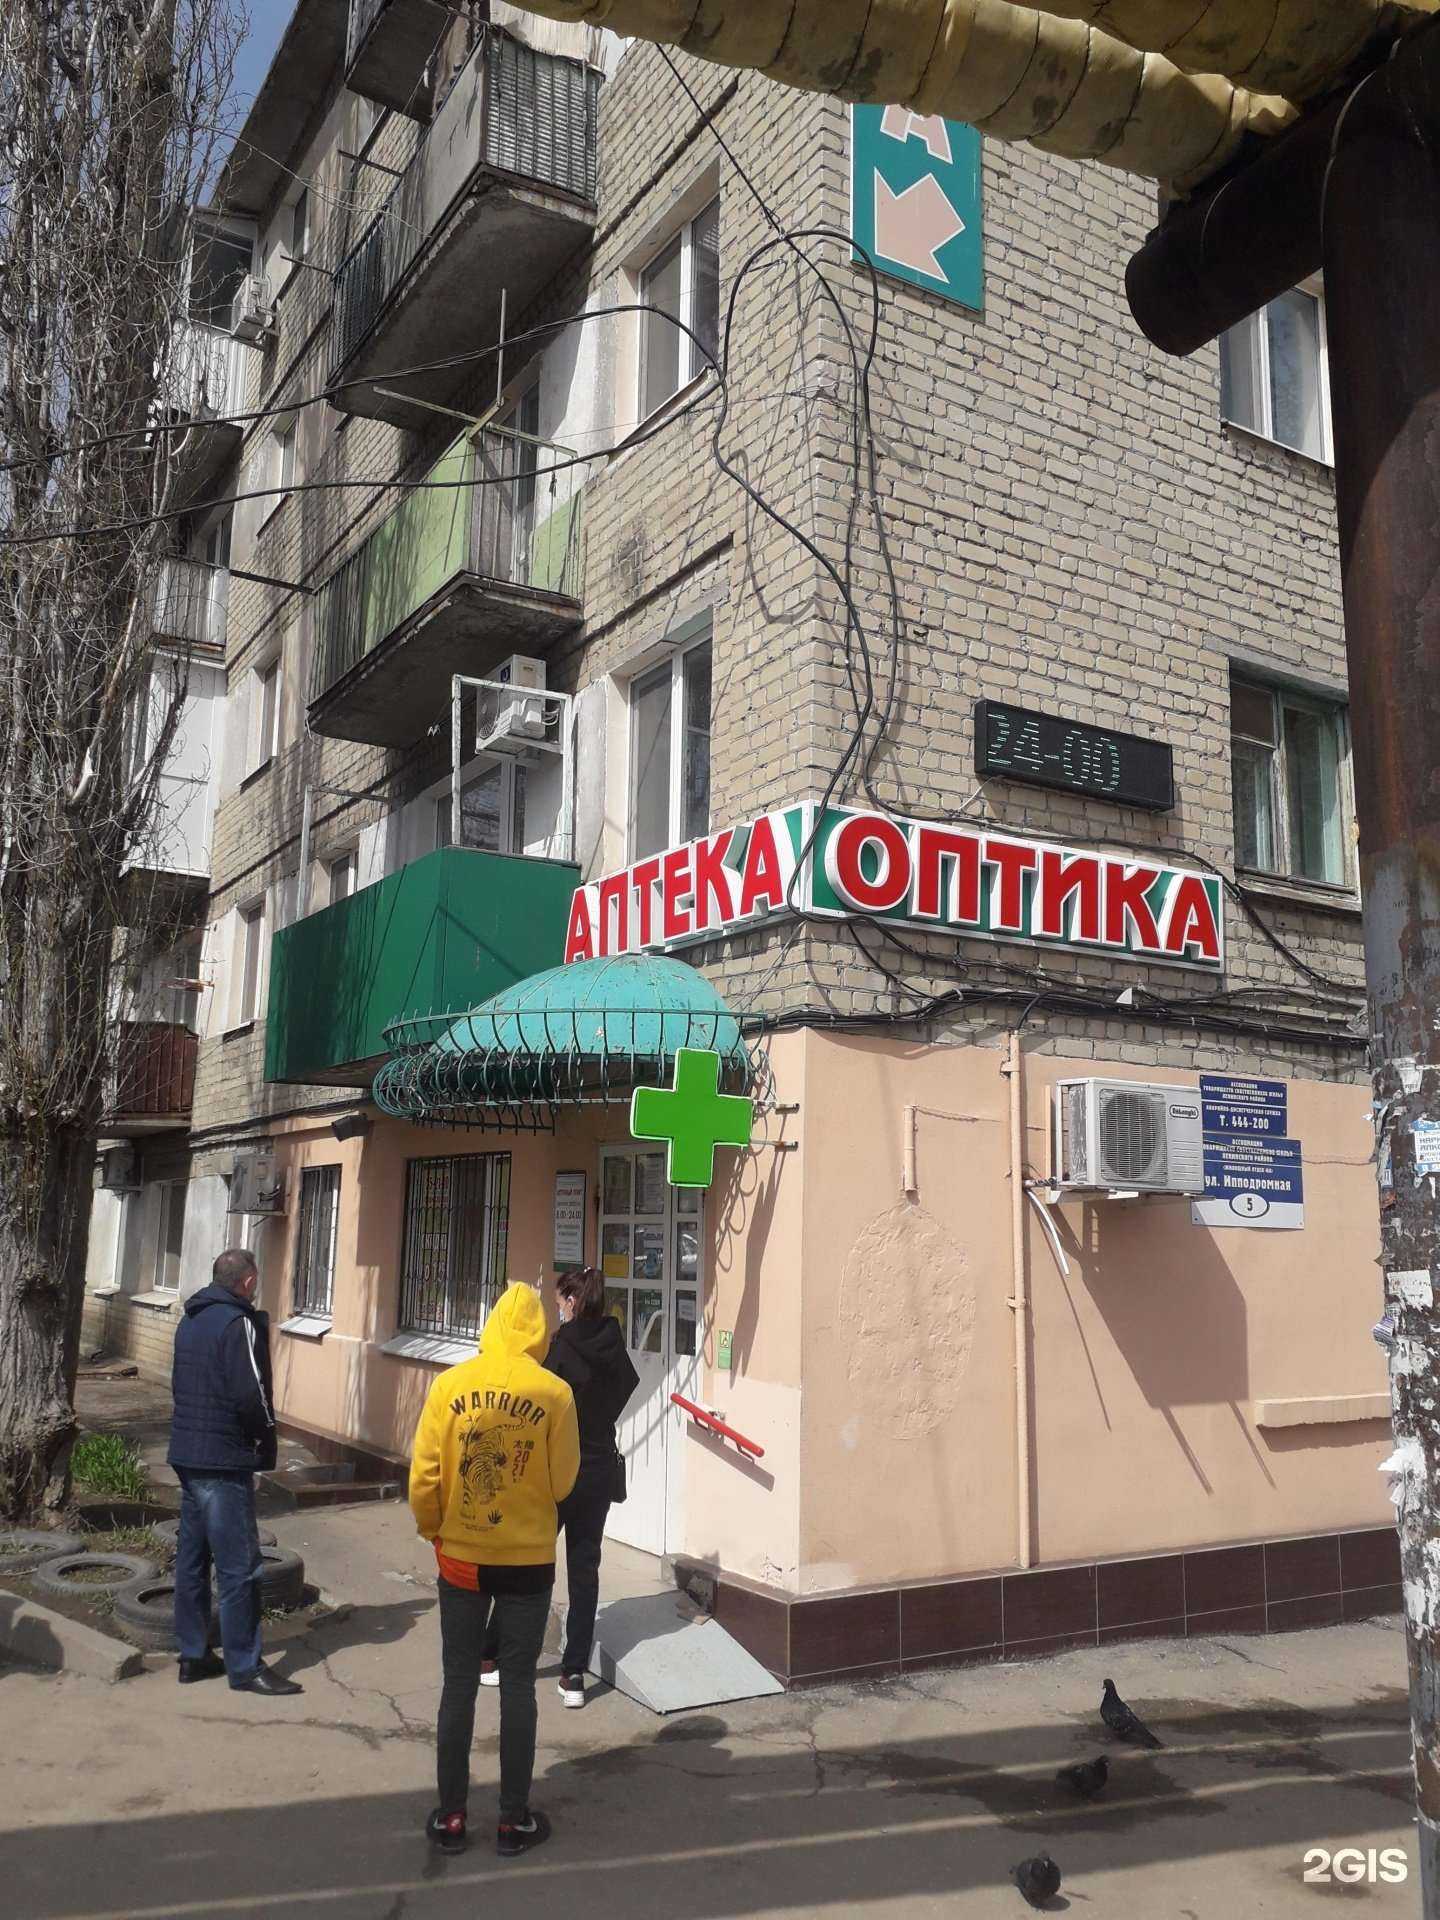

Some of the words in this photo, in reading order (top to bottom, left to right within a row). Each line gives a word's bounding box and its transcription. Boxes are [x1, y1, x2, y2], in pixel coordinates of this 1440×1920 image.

[987, 713, 1121, 792] 24-00
[564, 815, 786, 964] АПТЕКА
[826, 814, 1222, 961] ОПТИКА
[1232, 1115, 1269, 1130] 444-200
[1204, 1175, 1221, 1187] ул.
[1223, 1175, 1291, 1190] Ипподромная
[1247, 1197, 1253, 1211] 5
